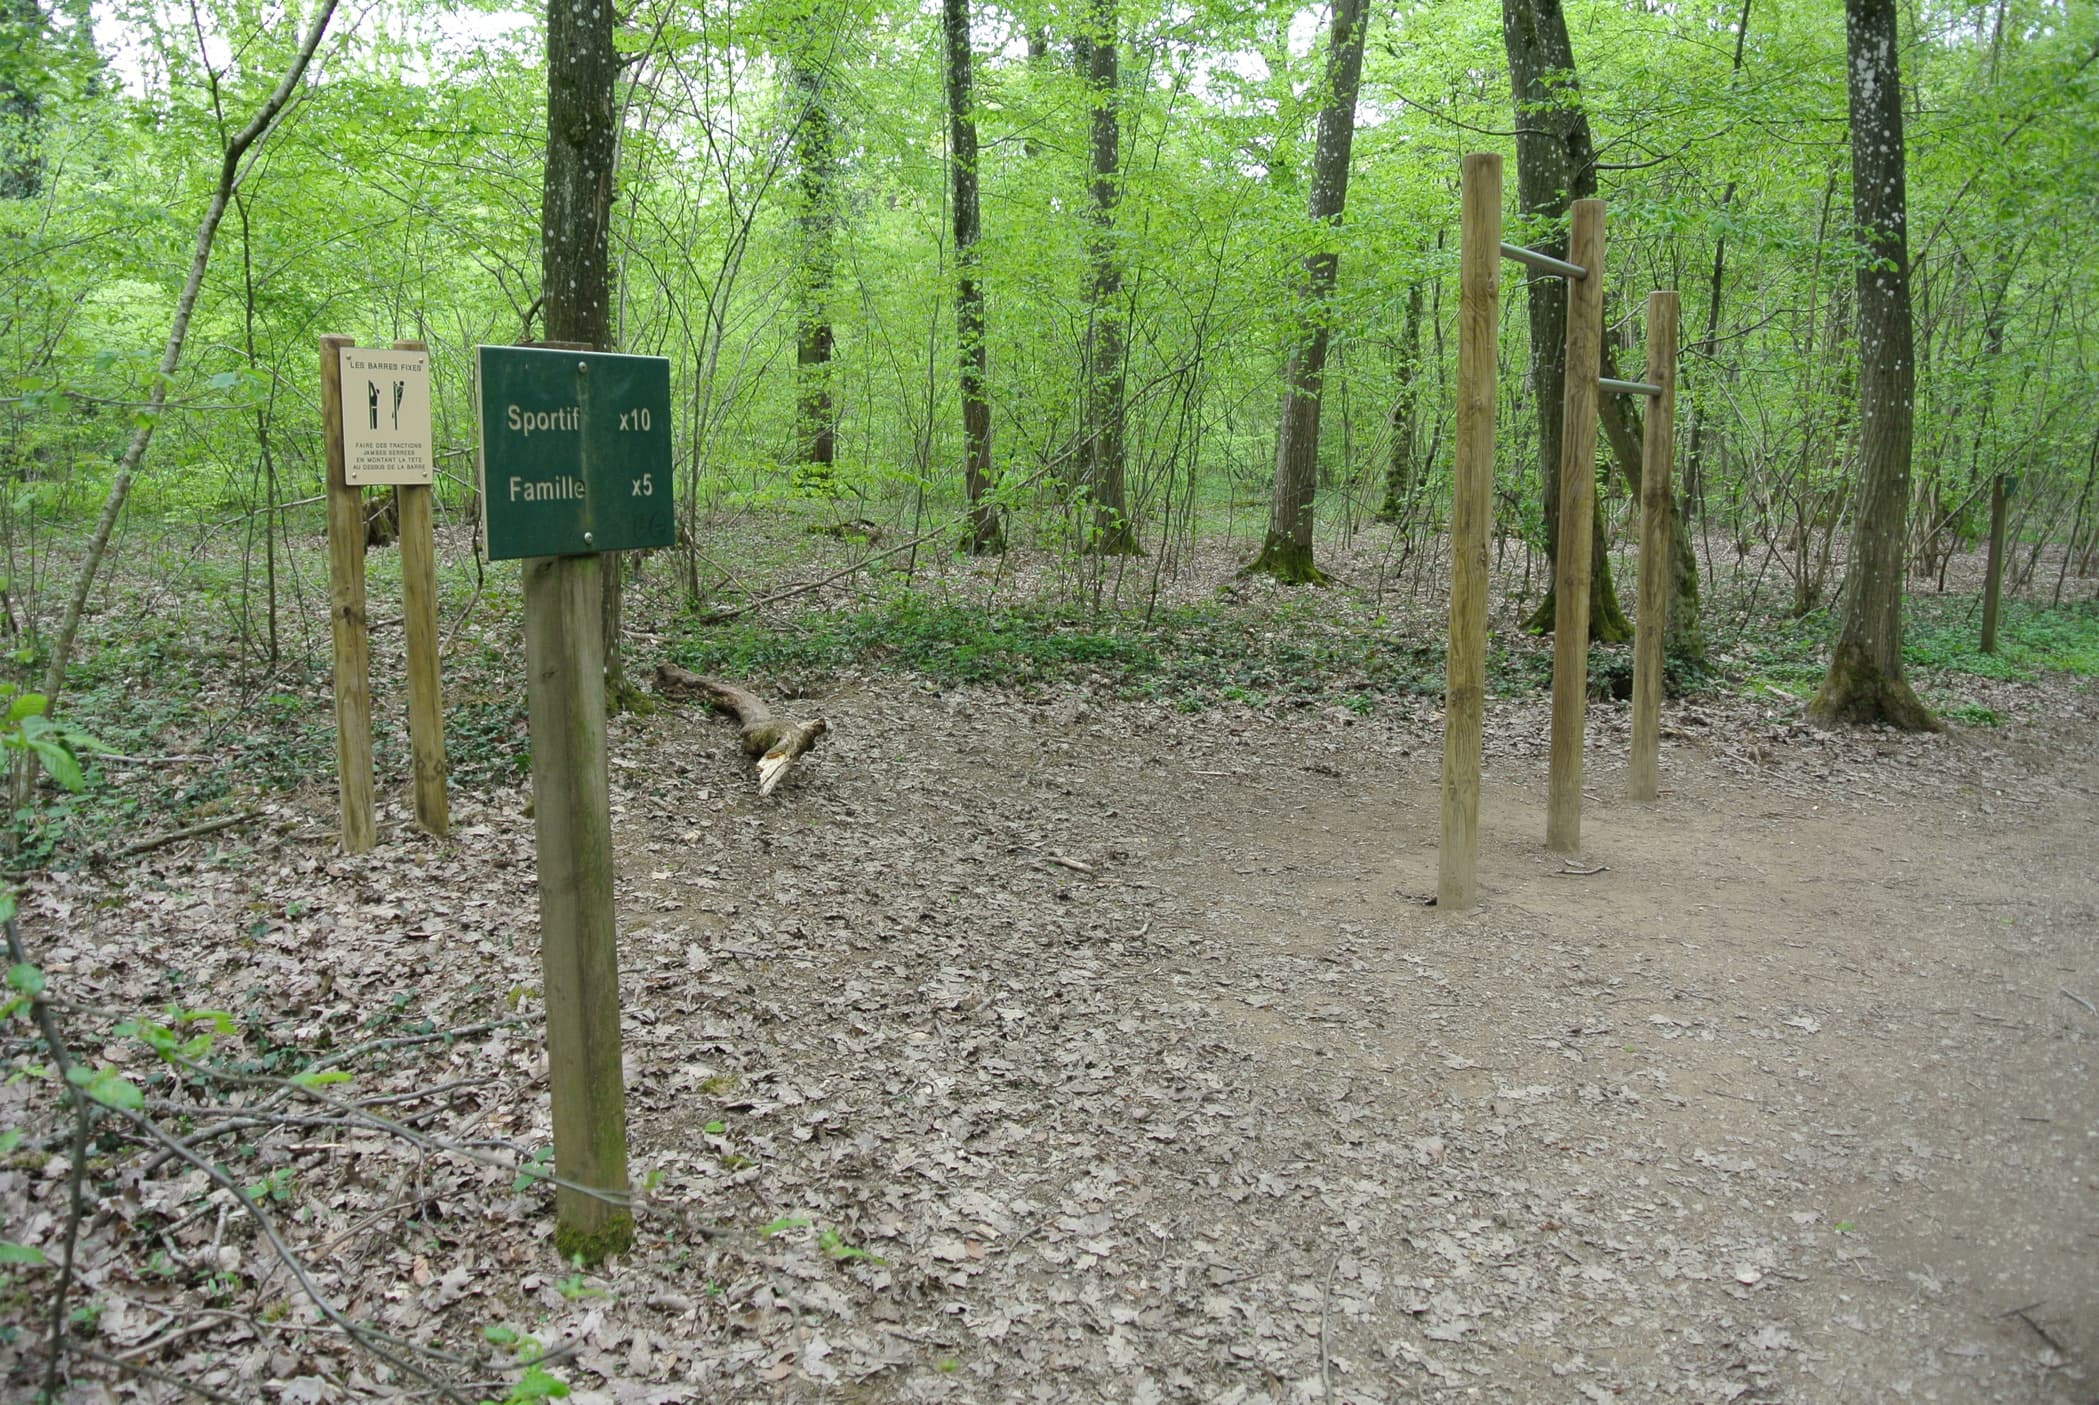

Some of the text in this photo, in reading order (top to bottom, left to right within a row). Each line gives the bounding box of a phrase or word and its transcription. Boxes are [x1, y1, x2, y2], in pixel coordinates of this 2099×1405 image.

[350, 361, 422, 372] LES BARRES FIXES
[507, 404, 651, 437] Sportif x10
[509, 473, 653, 502] Famille x5
